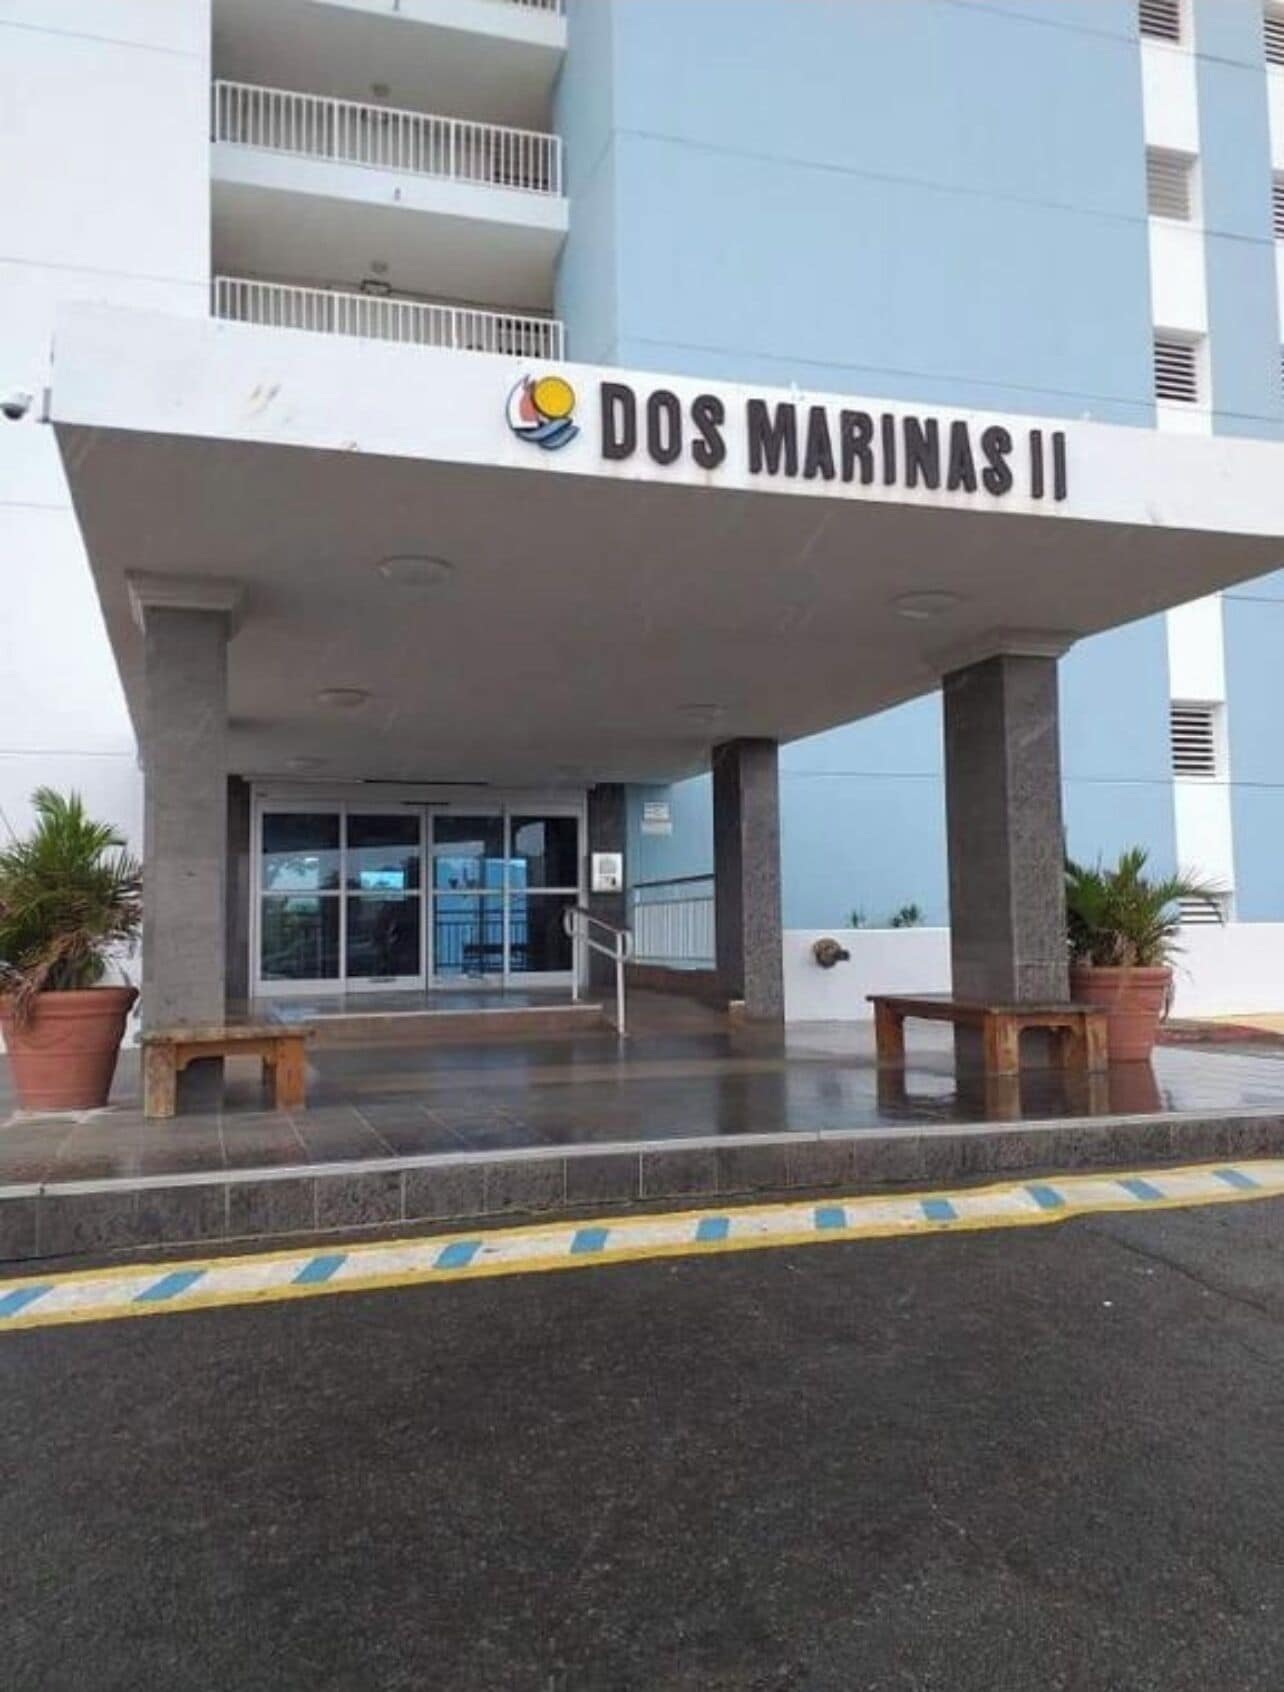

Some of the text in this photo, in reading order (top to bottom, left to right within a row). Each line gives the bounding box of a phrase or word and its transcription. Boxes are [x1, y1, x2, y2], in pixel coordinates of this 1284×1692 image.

[600, 382, 1066, 501] DOS MARINAS II
